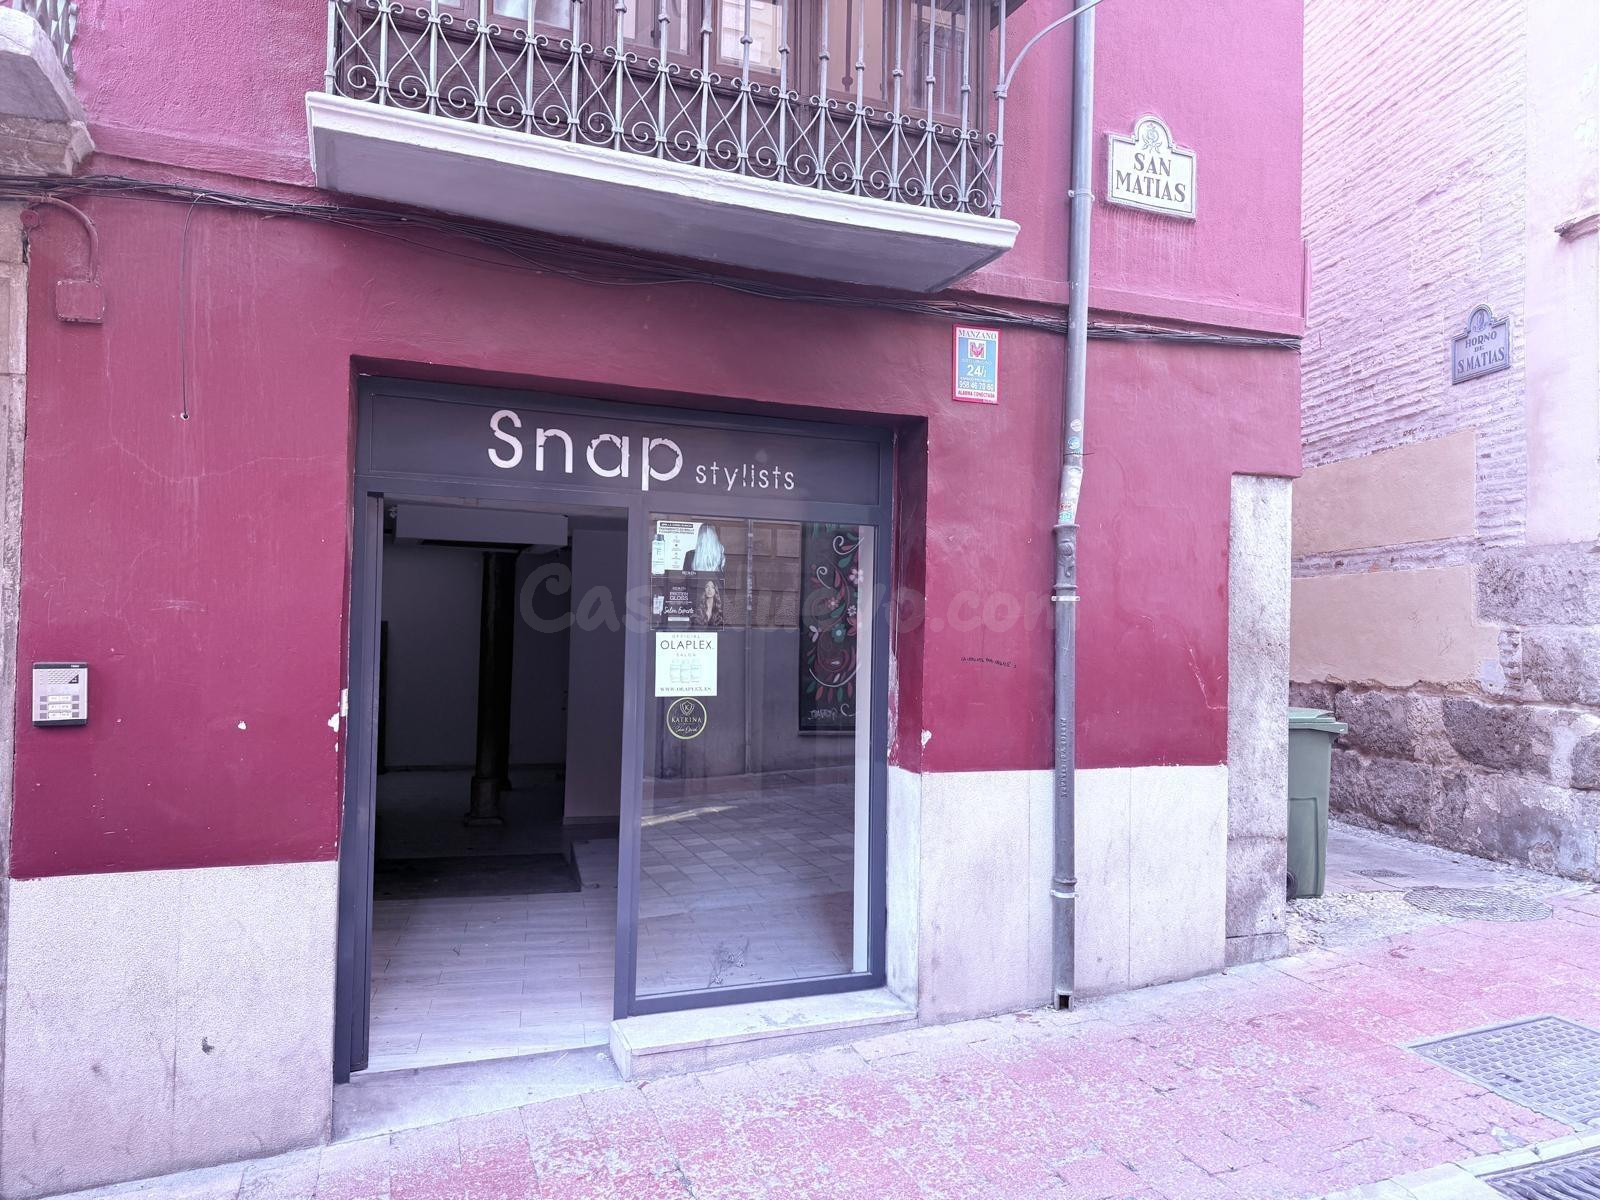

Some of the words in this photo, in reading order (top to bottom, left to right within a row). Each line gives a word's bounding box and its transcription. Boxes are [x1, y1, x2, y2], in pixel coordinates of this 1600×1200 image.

[1133, 152, 1172, 177] SAN
[1115, 169, 1186, 203] MATIAS
[958, 329, 997, 340] MANZANO
[1465, 330, 1497, 349] HORNO
[1474, 344, 1485, 353] DE
[488, 409, 683, 491] Snap
[695, 461, 795, 491] stylists
